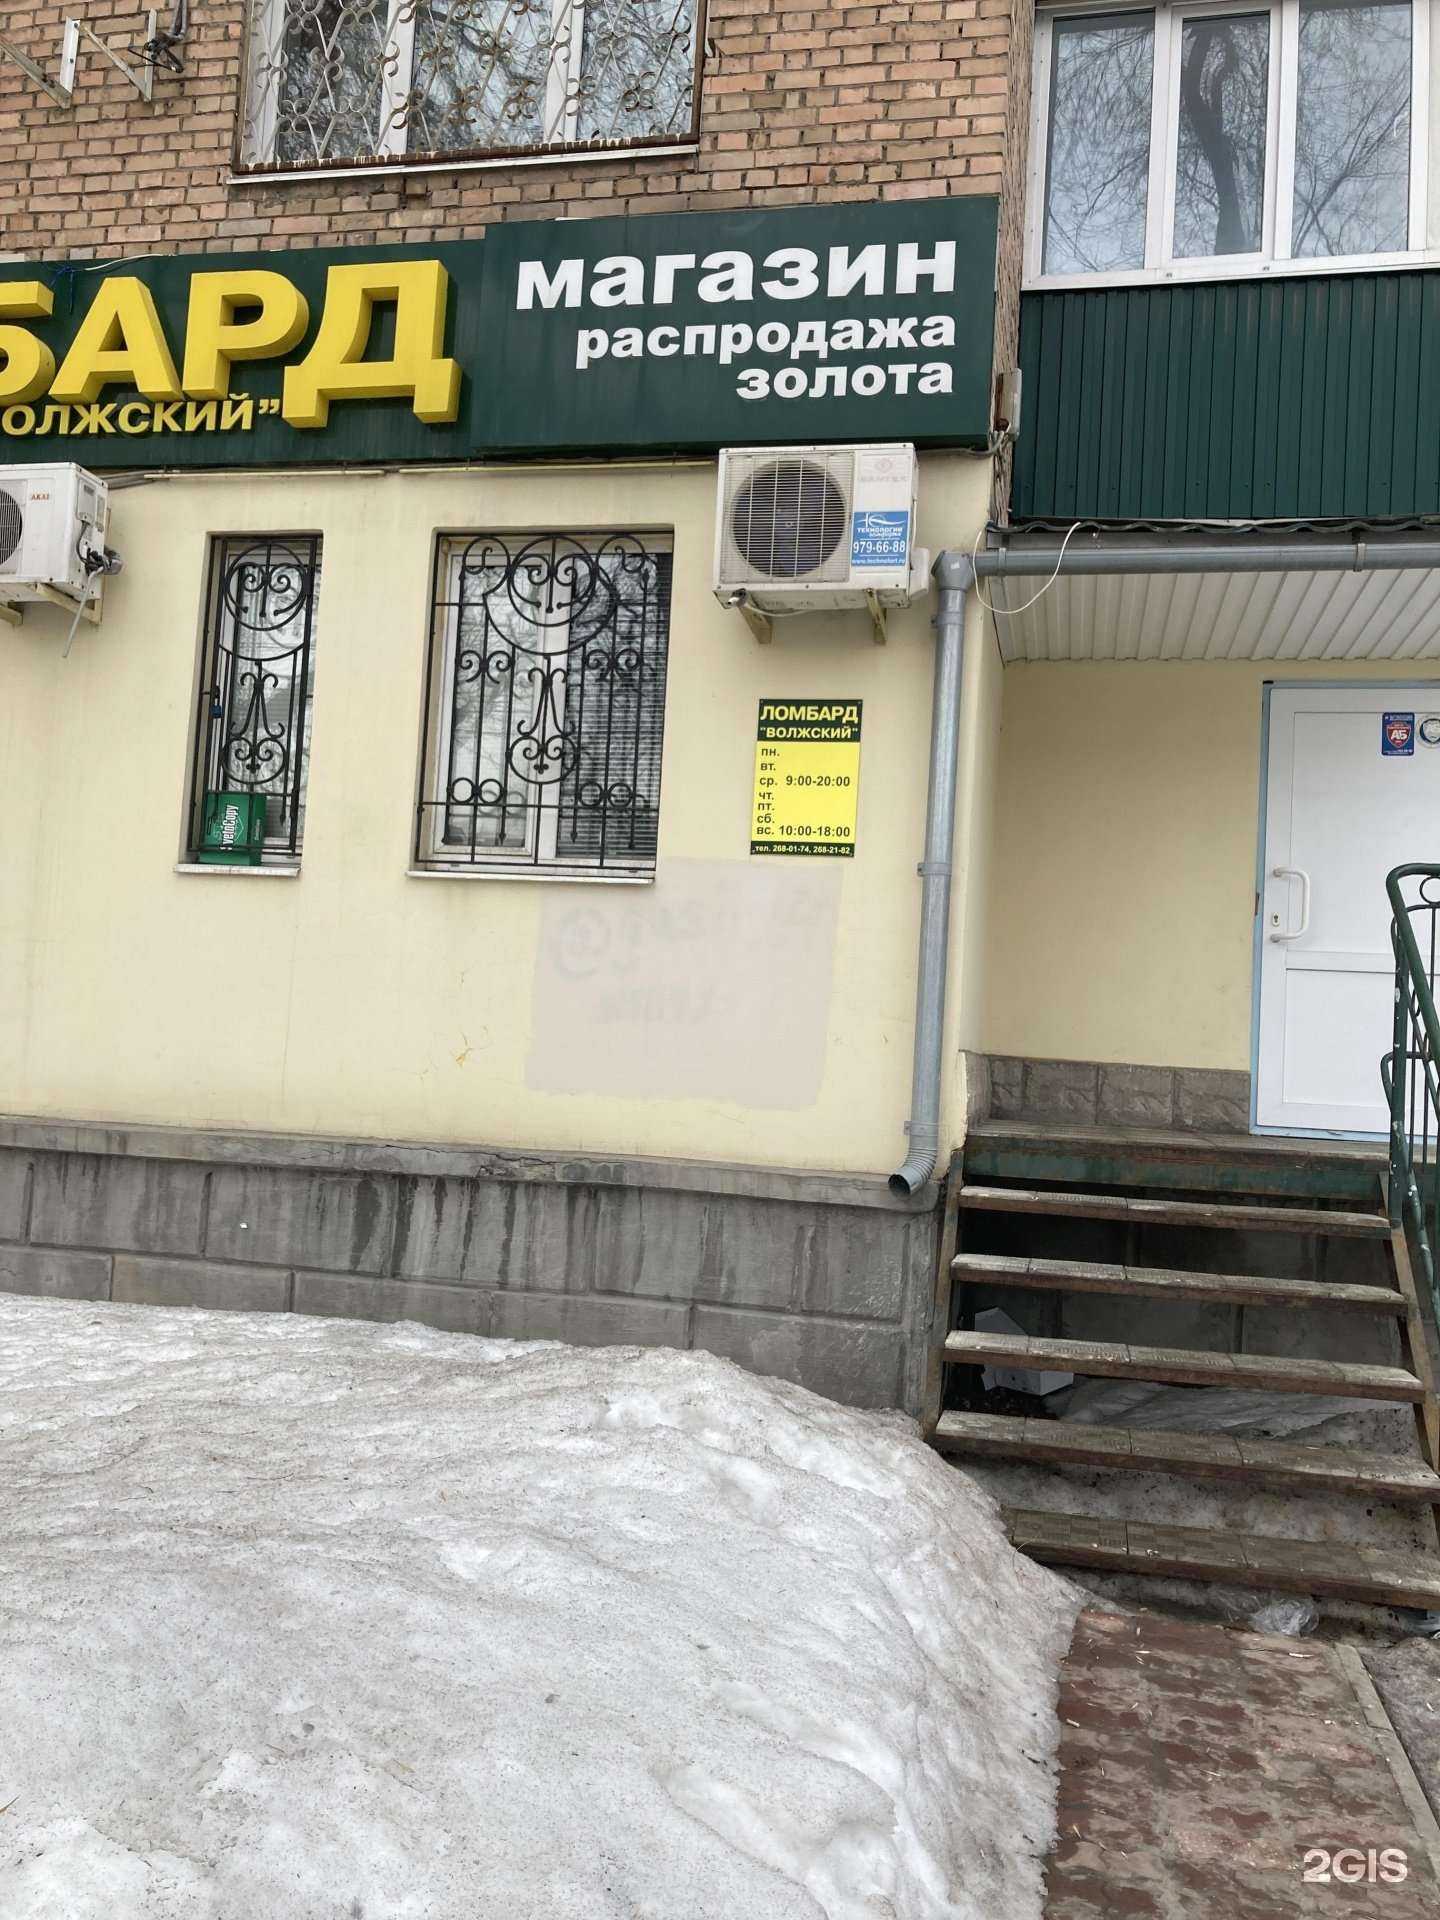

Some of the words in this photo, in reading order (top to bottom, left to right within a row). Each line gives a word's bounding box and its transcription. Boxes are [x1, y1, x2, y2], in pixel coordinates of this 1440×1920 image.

[515, 240, 957, 310] магазин
[575, 315, 956, 369] распродажа
[736, 362, 953, 400] золота
[760, 705, 858, 724] ЛОМБАРД
[761, 748, 780, 757] пн.
[760, 763, 776, 771] вт.
[759, 777, 778, 787] ср.
[786, 775, 850, 787] 9:00-20:00
[758, 792, 774, 800] чт.
[758, 803, 775, 811] пт.
[757, 813, 775, 823] сб.
[756, 827, 774, 835] вс.
[779, 825, 850, 837] 10:00-18:00
